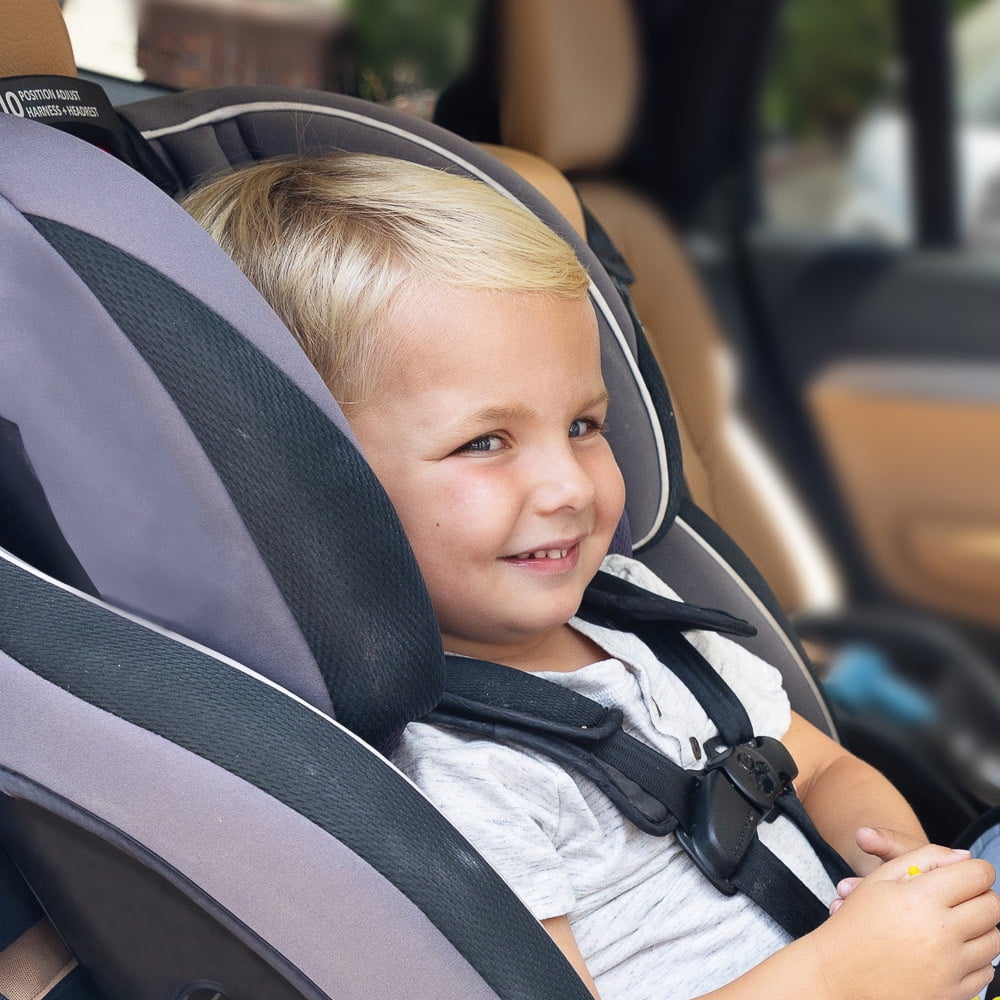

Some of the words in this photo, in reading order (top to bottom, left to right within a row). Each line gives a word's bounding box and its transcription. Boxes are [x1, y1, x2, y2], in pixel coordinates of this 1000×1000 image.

[18, 89, 56, 101] POSITION
[56, 89, 80, 101] ADJUST
[26, 105, 62, 118] HARNESS
[66, 105, 99, 117] HEADREST
